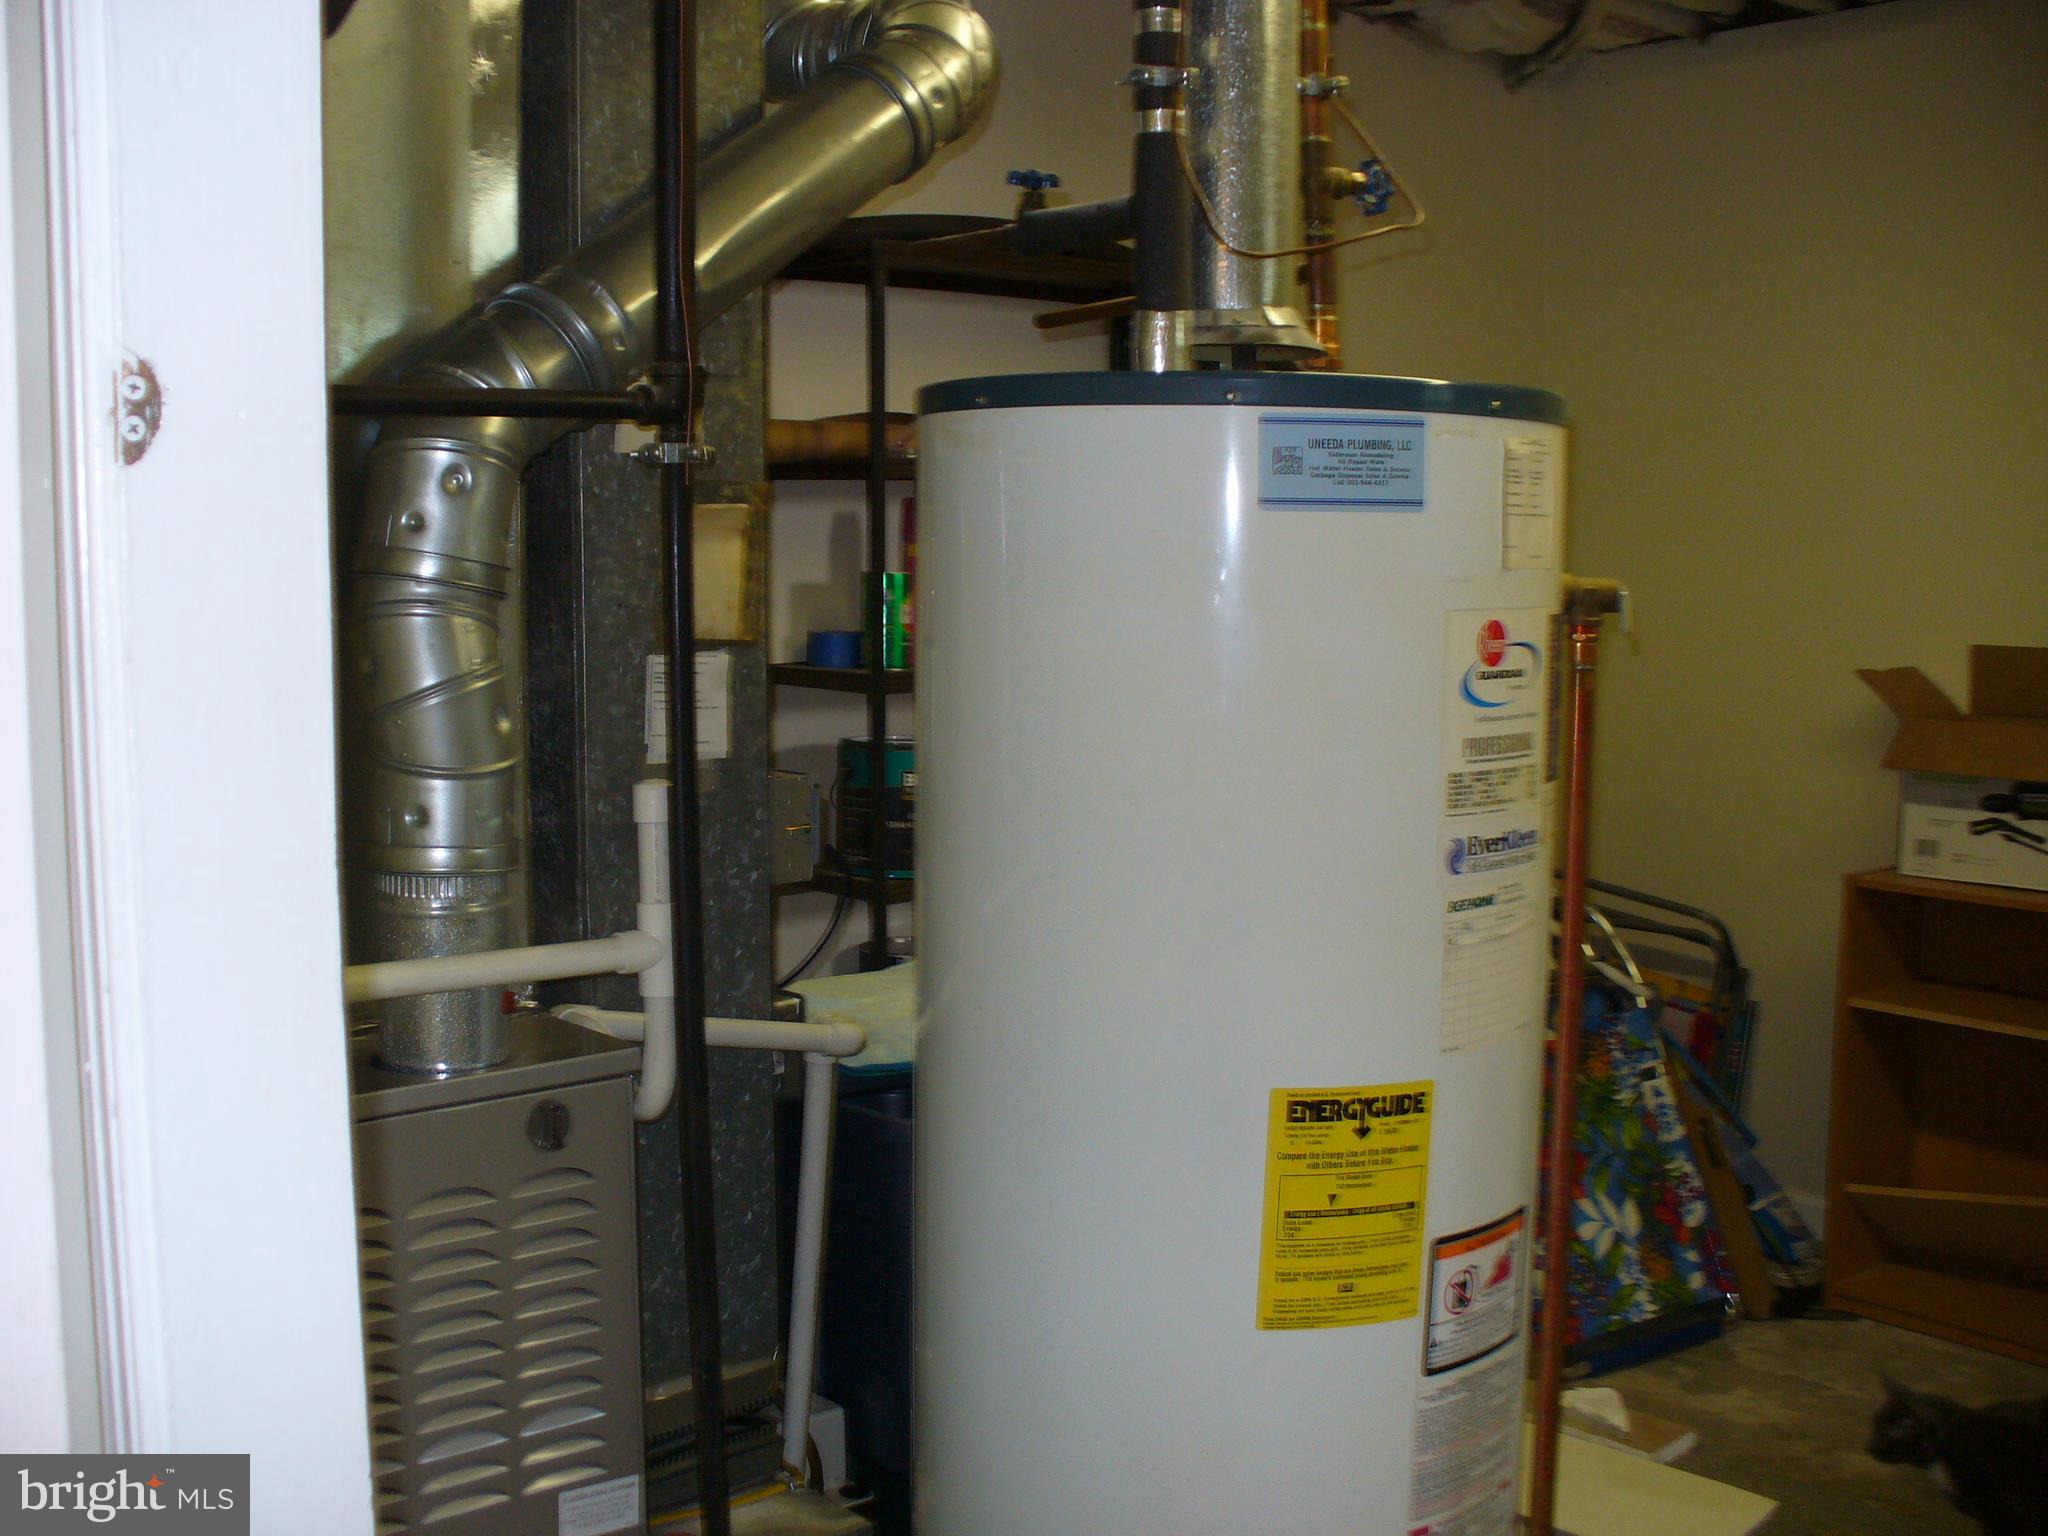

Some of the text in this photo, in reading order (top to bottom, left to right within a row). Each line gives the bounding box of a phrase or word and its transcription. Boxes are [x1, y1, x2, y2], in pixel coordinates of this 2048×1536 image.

[1307, 438, 1412, 451] UNEEDA PLUMBING, LLC
[1286, 1092, 1425, 1123] ENERGYGUIDE
[1276, 1151, 1307, 1162] Compare
[1309, 1151, 1321, 1160] the
[1321, 1150, 1345, 1161] Energy
[1306, 1160, 1320, 1170] with
[1321, 1159, 1343, 1170] Others
